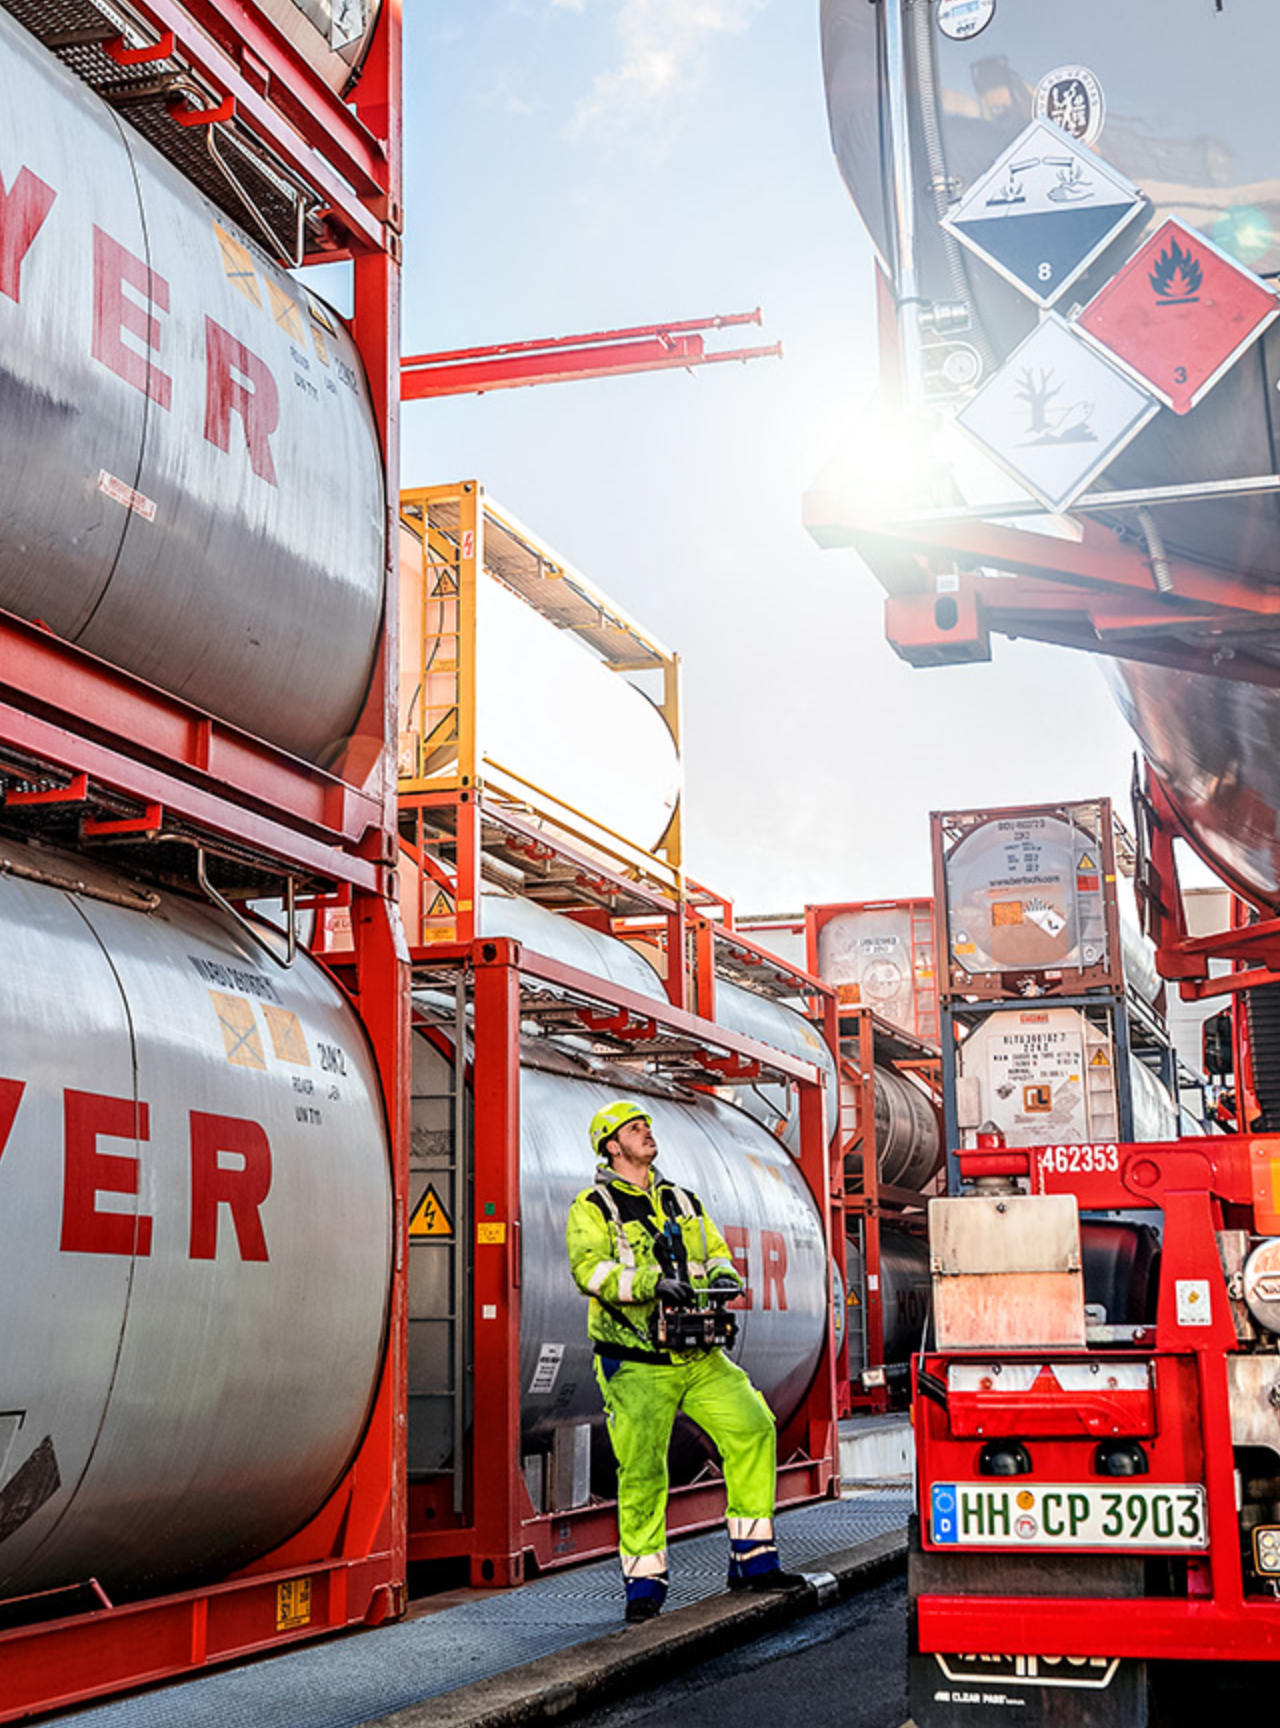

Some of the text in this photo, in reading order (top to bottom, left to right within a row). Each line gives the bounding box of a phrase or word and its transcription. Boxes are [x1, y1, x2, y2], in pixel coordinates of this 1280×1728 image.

[1037, 262, 1052, 282] 8
[1173, 366, 1188, 384] 3
[1043, 1145, 1119, 1173] 462353
[961, 1493, 1200, 1538] HH CP 3903
[940, 1519, 951, 1533] D
